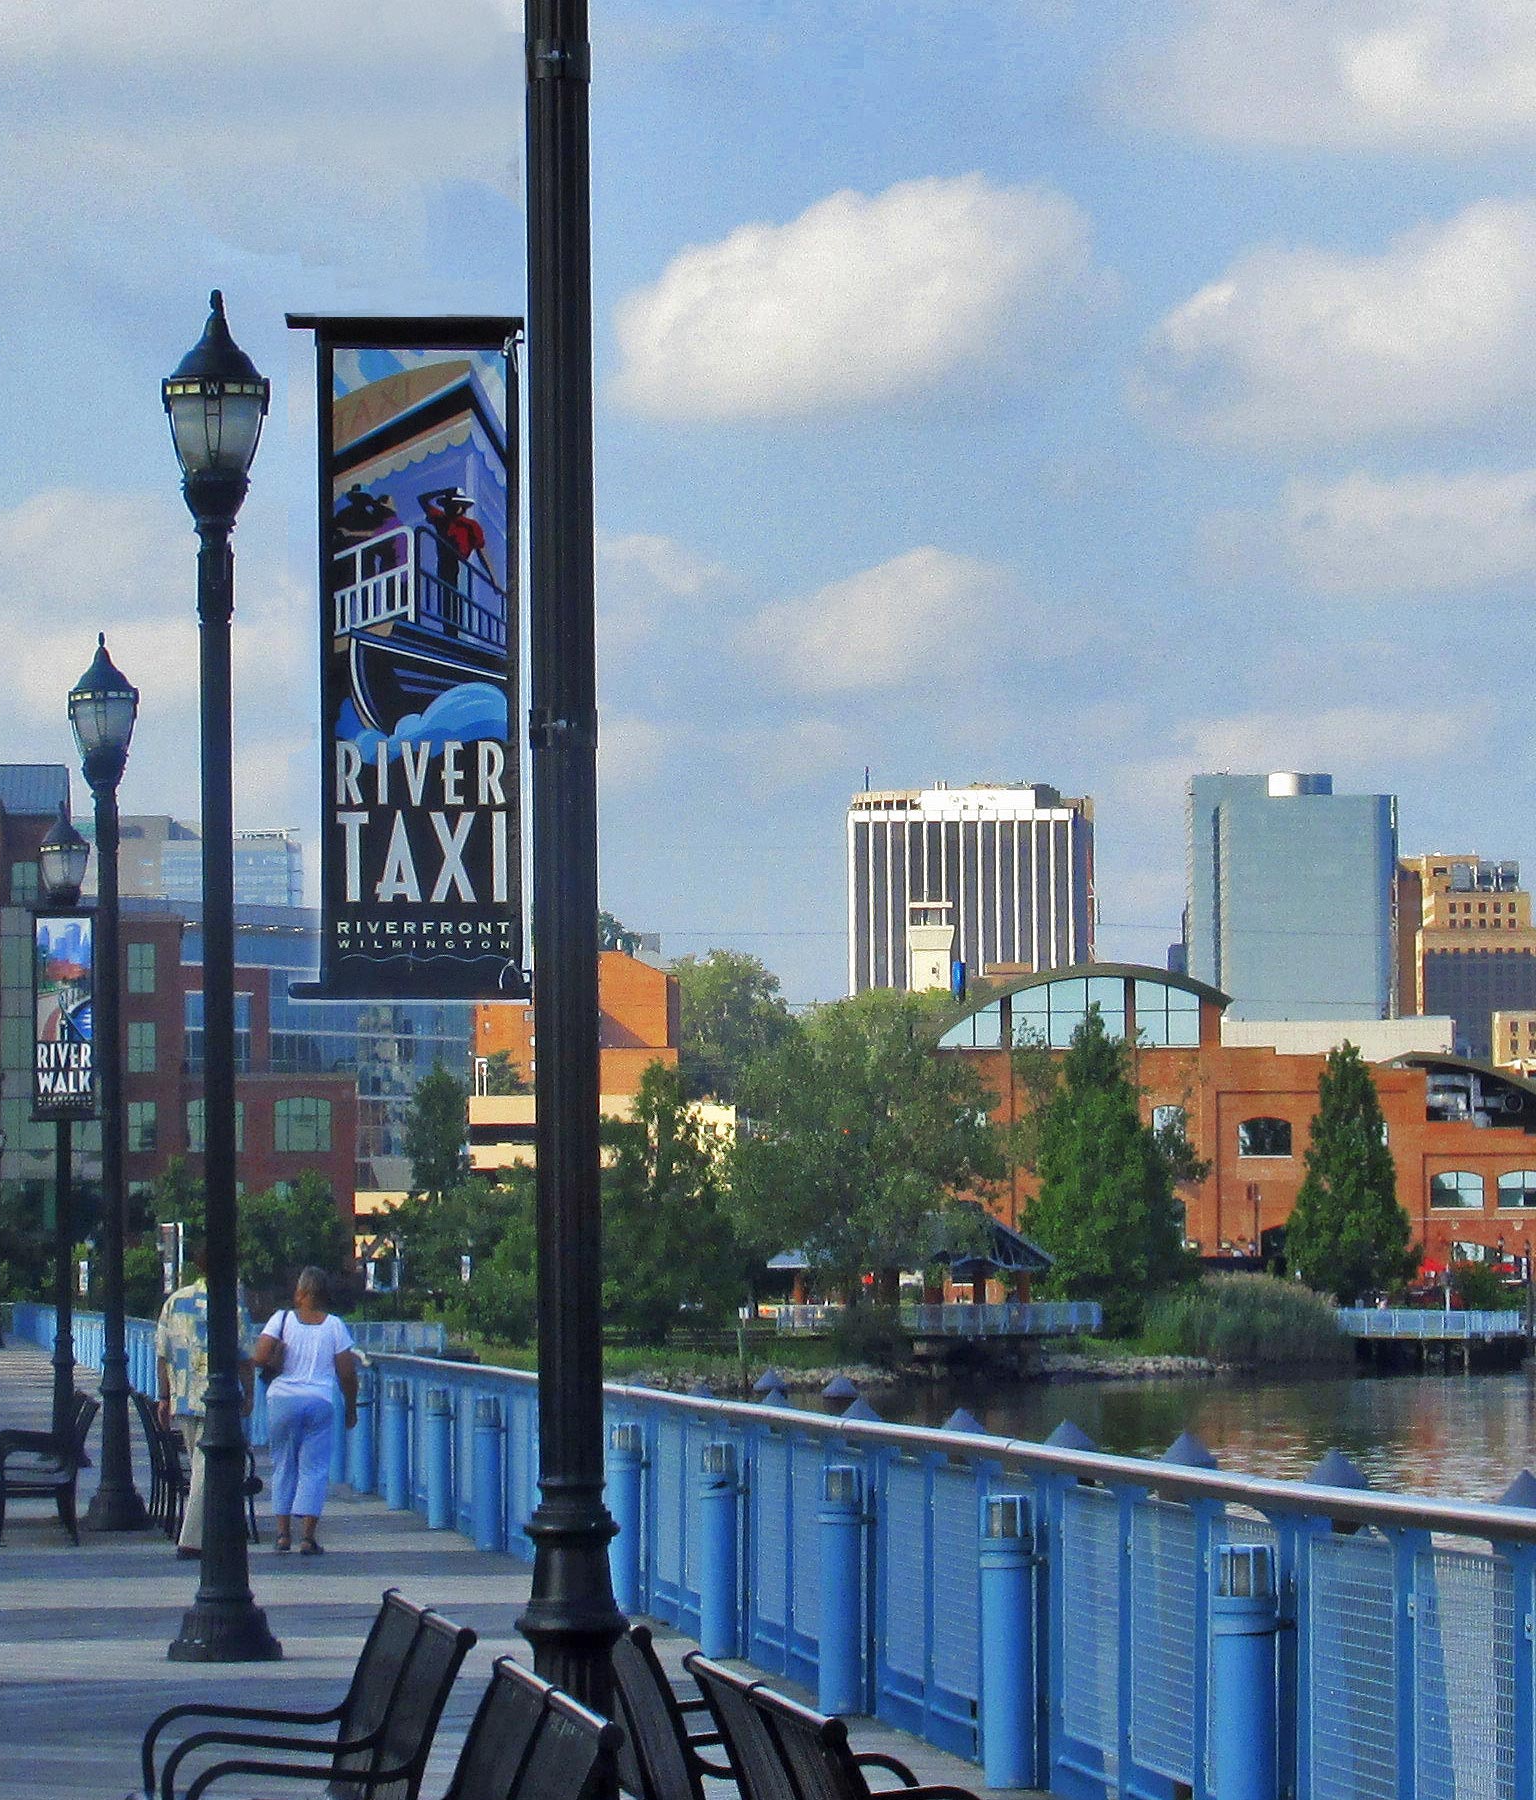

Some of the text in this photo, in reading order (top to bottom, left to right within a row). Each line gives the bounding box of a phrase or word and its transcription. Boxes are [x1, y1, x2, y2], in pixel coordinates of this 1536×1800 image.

[205, 381, 220, 395] W
[335, 740, 507, 806] RIVER
[336, 809, 508, 903] TAXI
[336, 921, 511, 935] RIVERFRONT
[337, 939, 511, 950] WILMINGTON
[36, 1042, 92, 1069] RIVER
[36, 1070, 92, 1094] WALK
